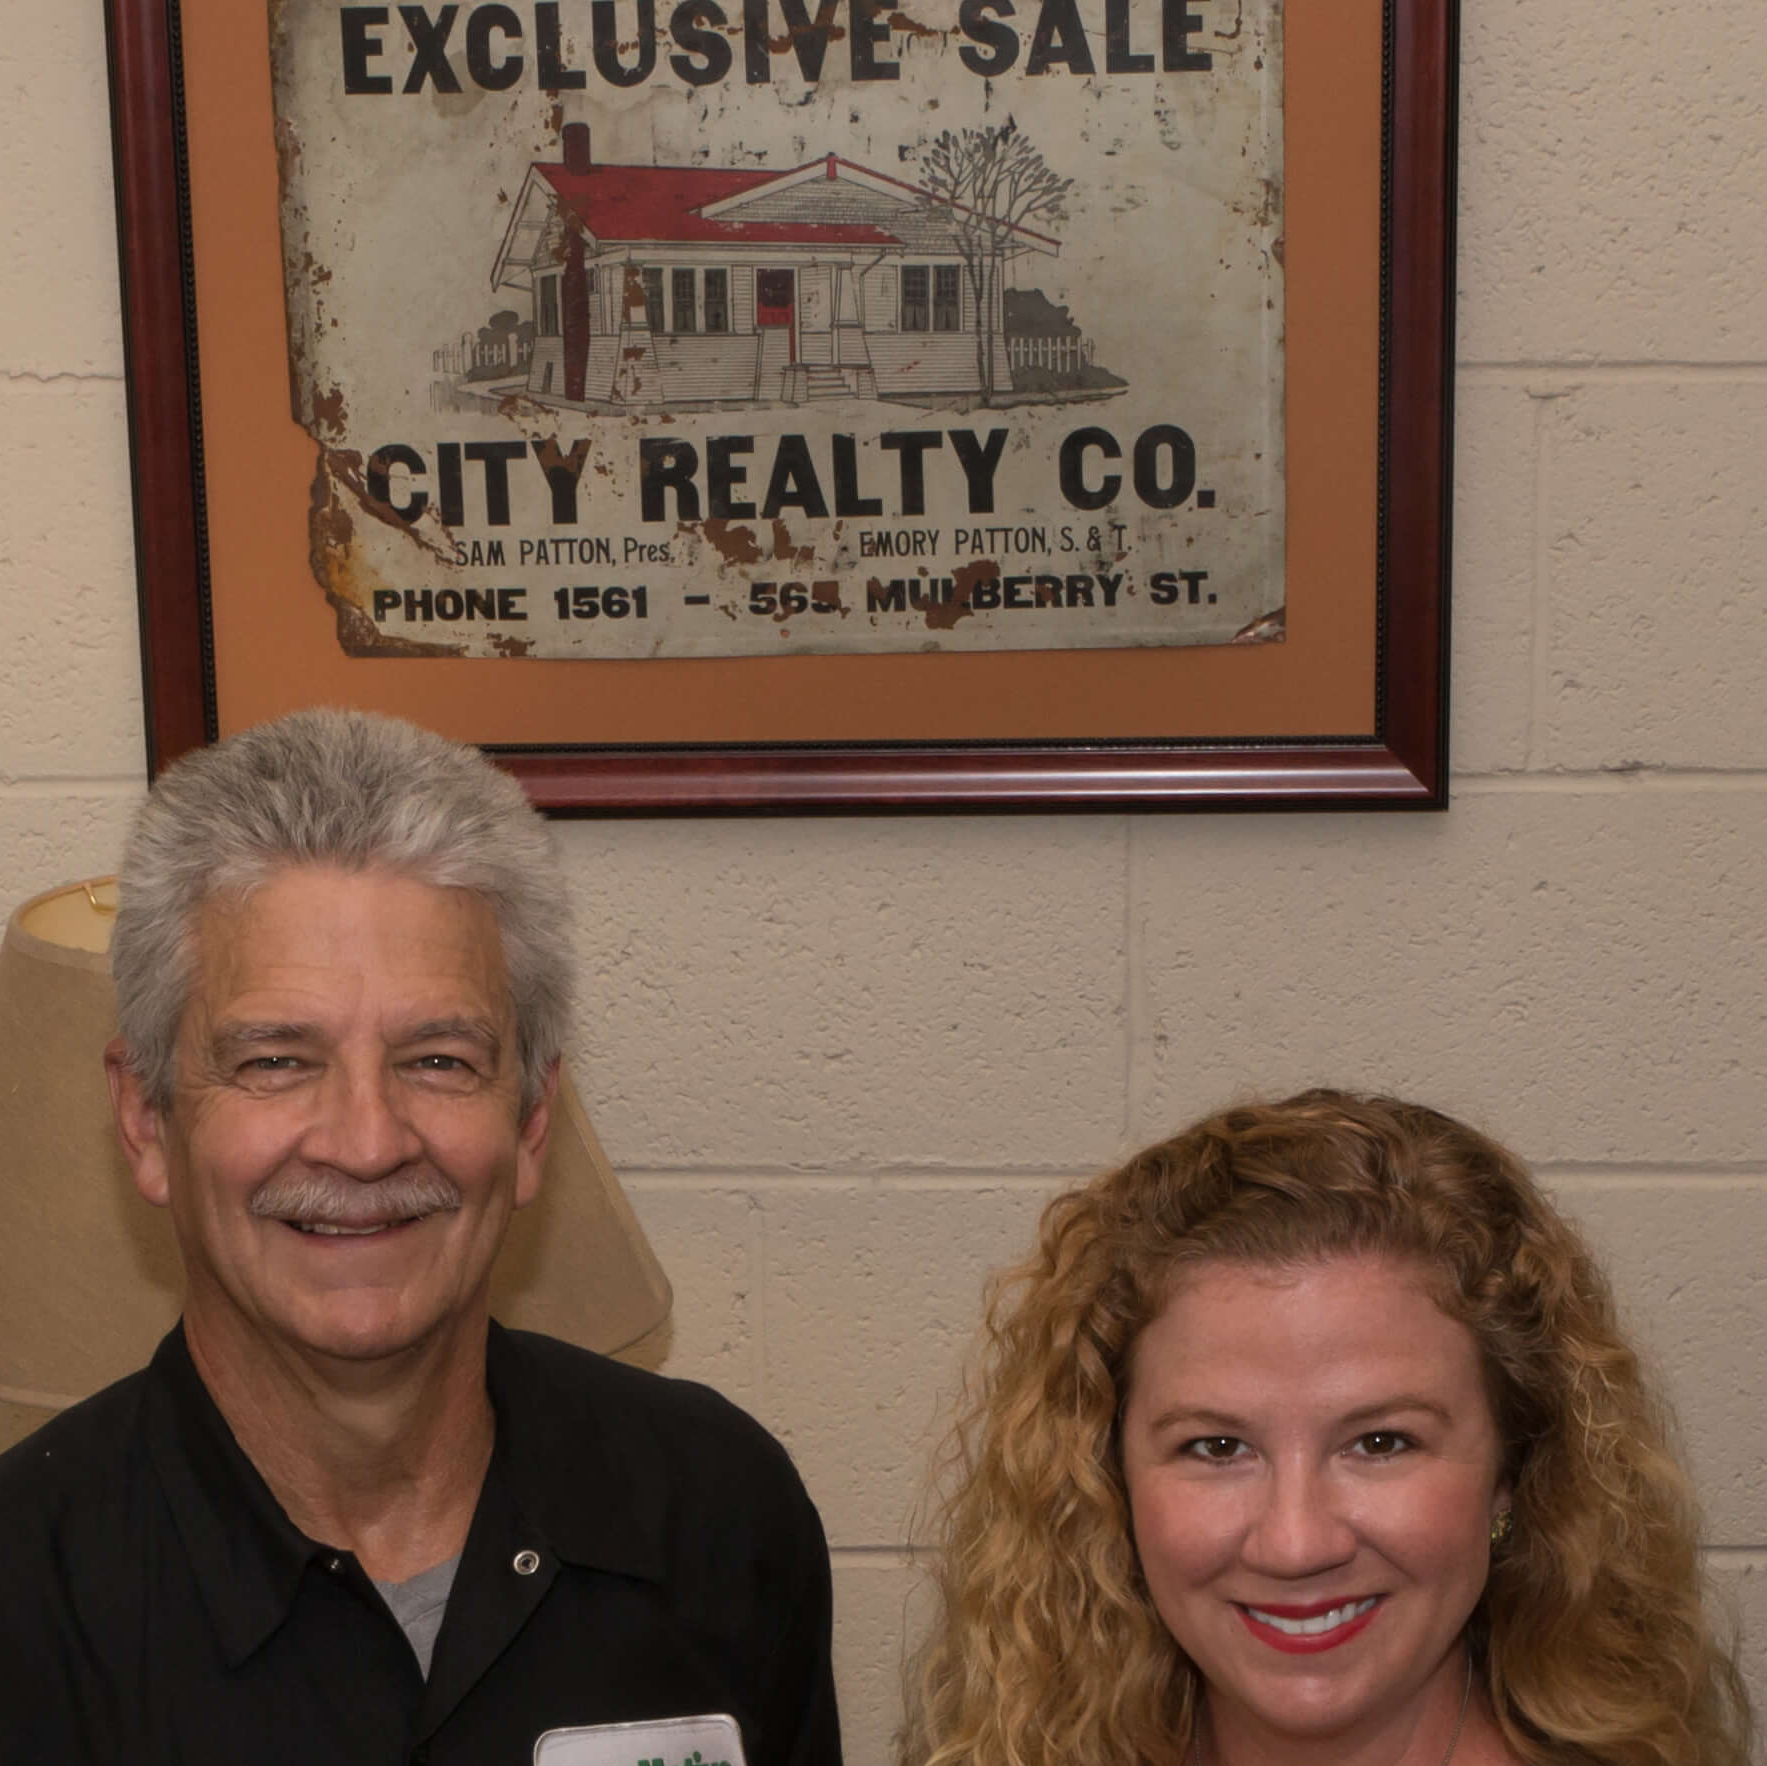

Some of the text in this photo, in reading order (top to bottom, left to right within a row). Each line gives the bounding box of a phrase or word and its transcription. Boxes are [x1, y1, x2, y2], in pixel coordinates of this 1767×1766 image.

[341, 0, 1213, 95] EXCLUSIVE SALE
[366, 425, 1216, 527] CITY REALTY CO.
[455, 539, 506, 567] SAM
[519, 537, 616, 567] PATTON,
[860, 529, 940, 557] EMORY
[954, 526, 1052, 556] PATTON,
[373, 588, 528, 621] PHONE
[553, 586, 648, 620] 1561
[1149, 571, 1217, 605] ST.
